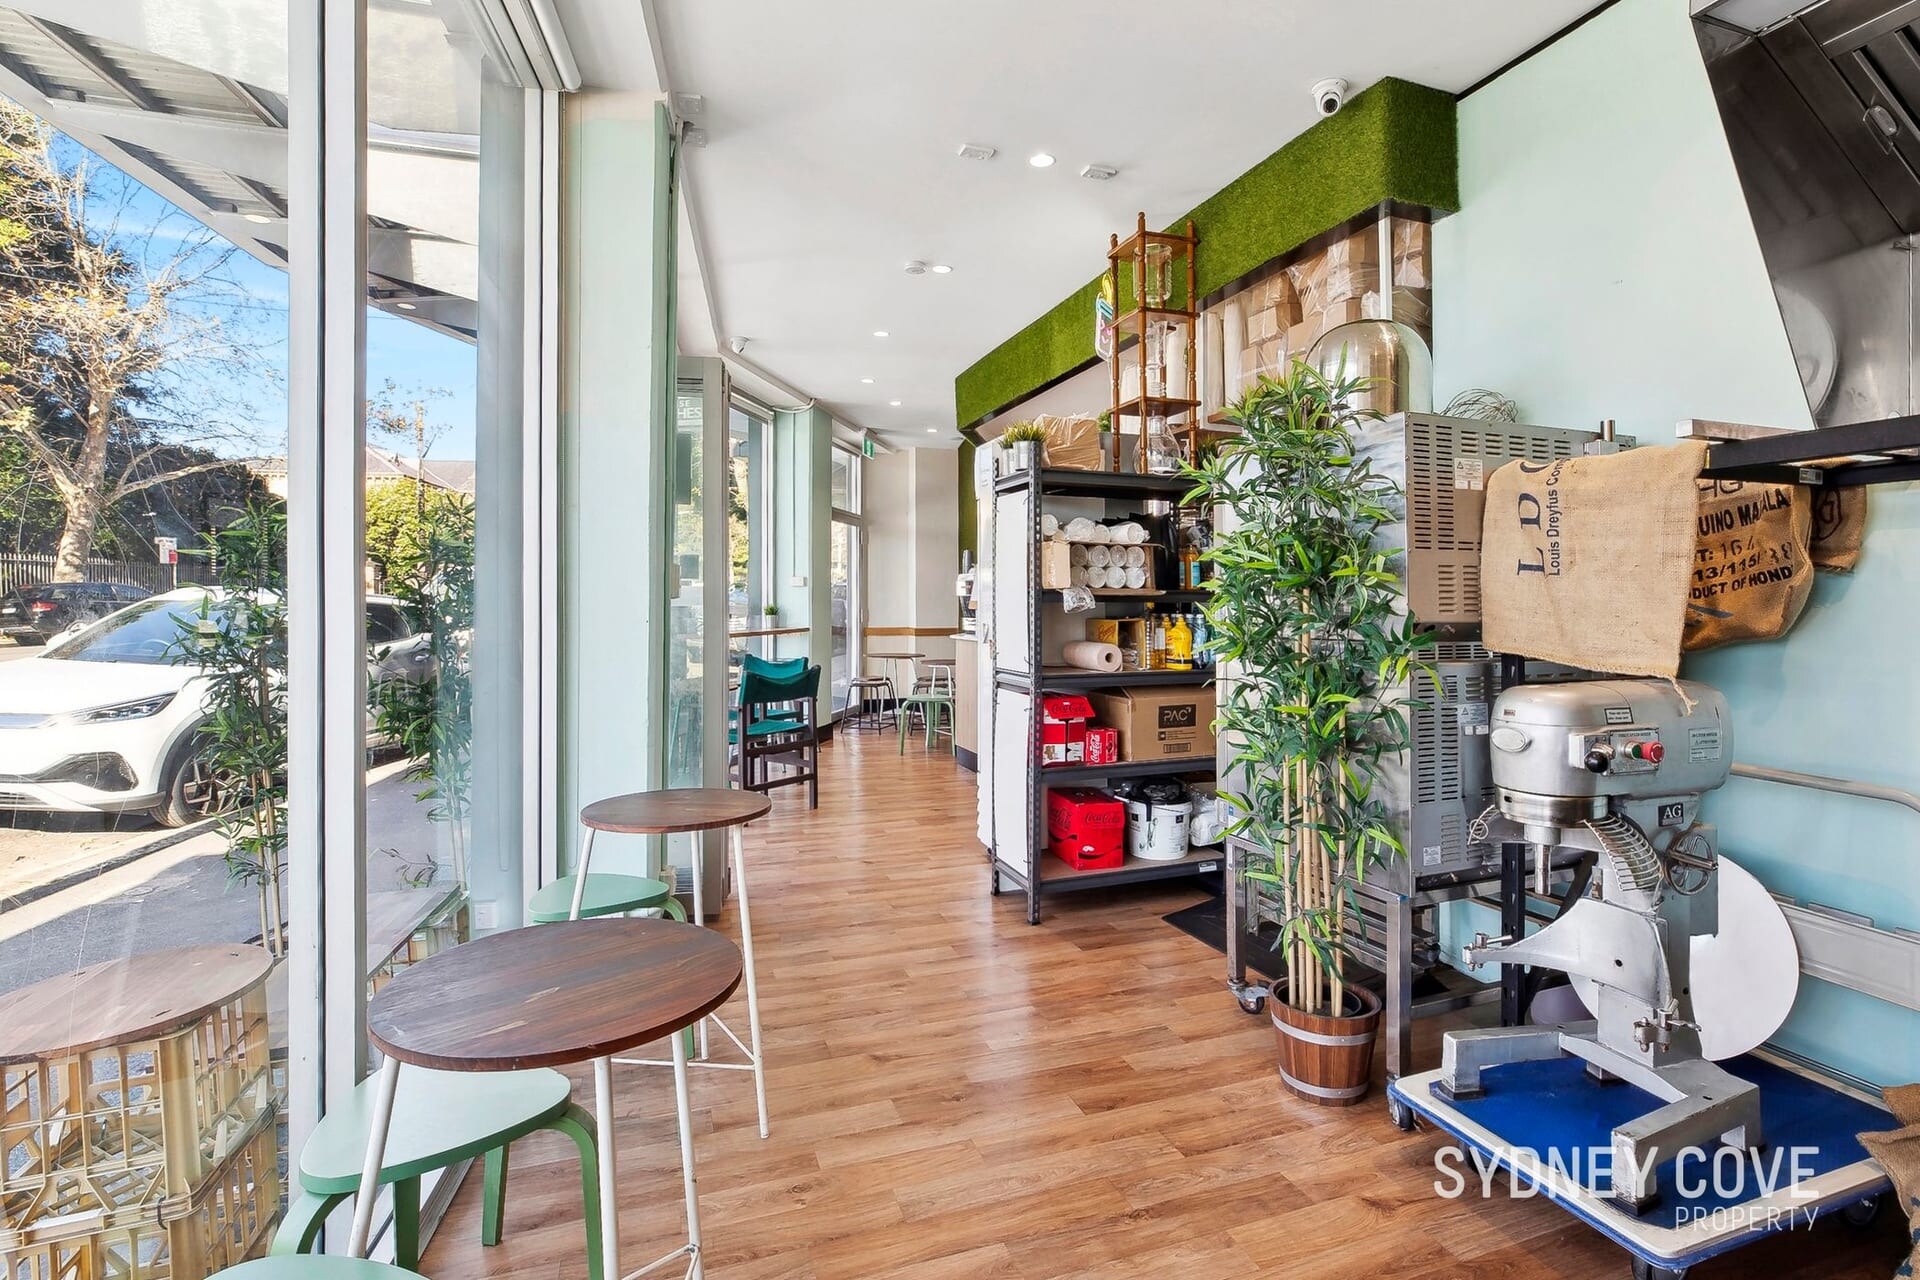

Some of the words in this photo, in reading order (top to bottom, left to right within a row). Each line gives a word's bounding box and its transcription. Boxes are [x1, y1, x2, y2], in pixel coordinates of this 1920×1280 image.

[1546, 489, 1562, 537] Dreyfus
[1697, 509, 1734, 537] UINO
[1548, 541, 1560, 576] Louis
[1689, 581, 1728, 600] DUCT
[1731, 577, 1747, 591] OF
[1748, 564, 1794, 588] HOND
[1663, 804, 1682, 820] AG
